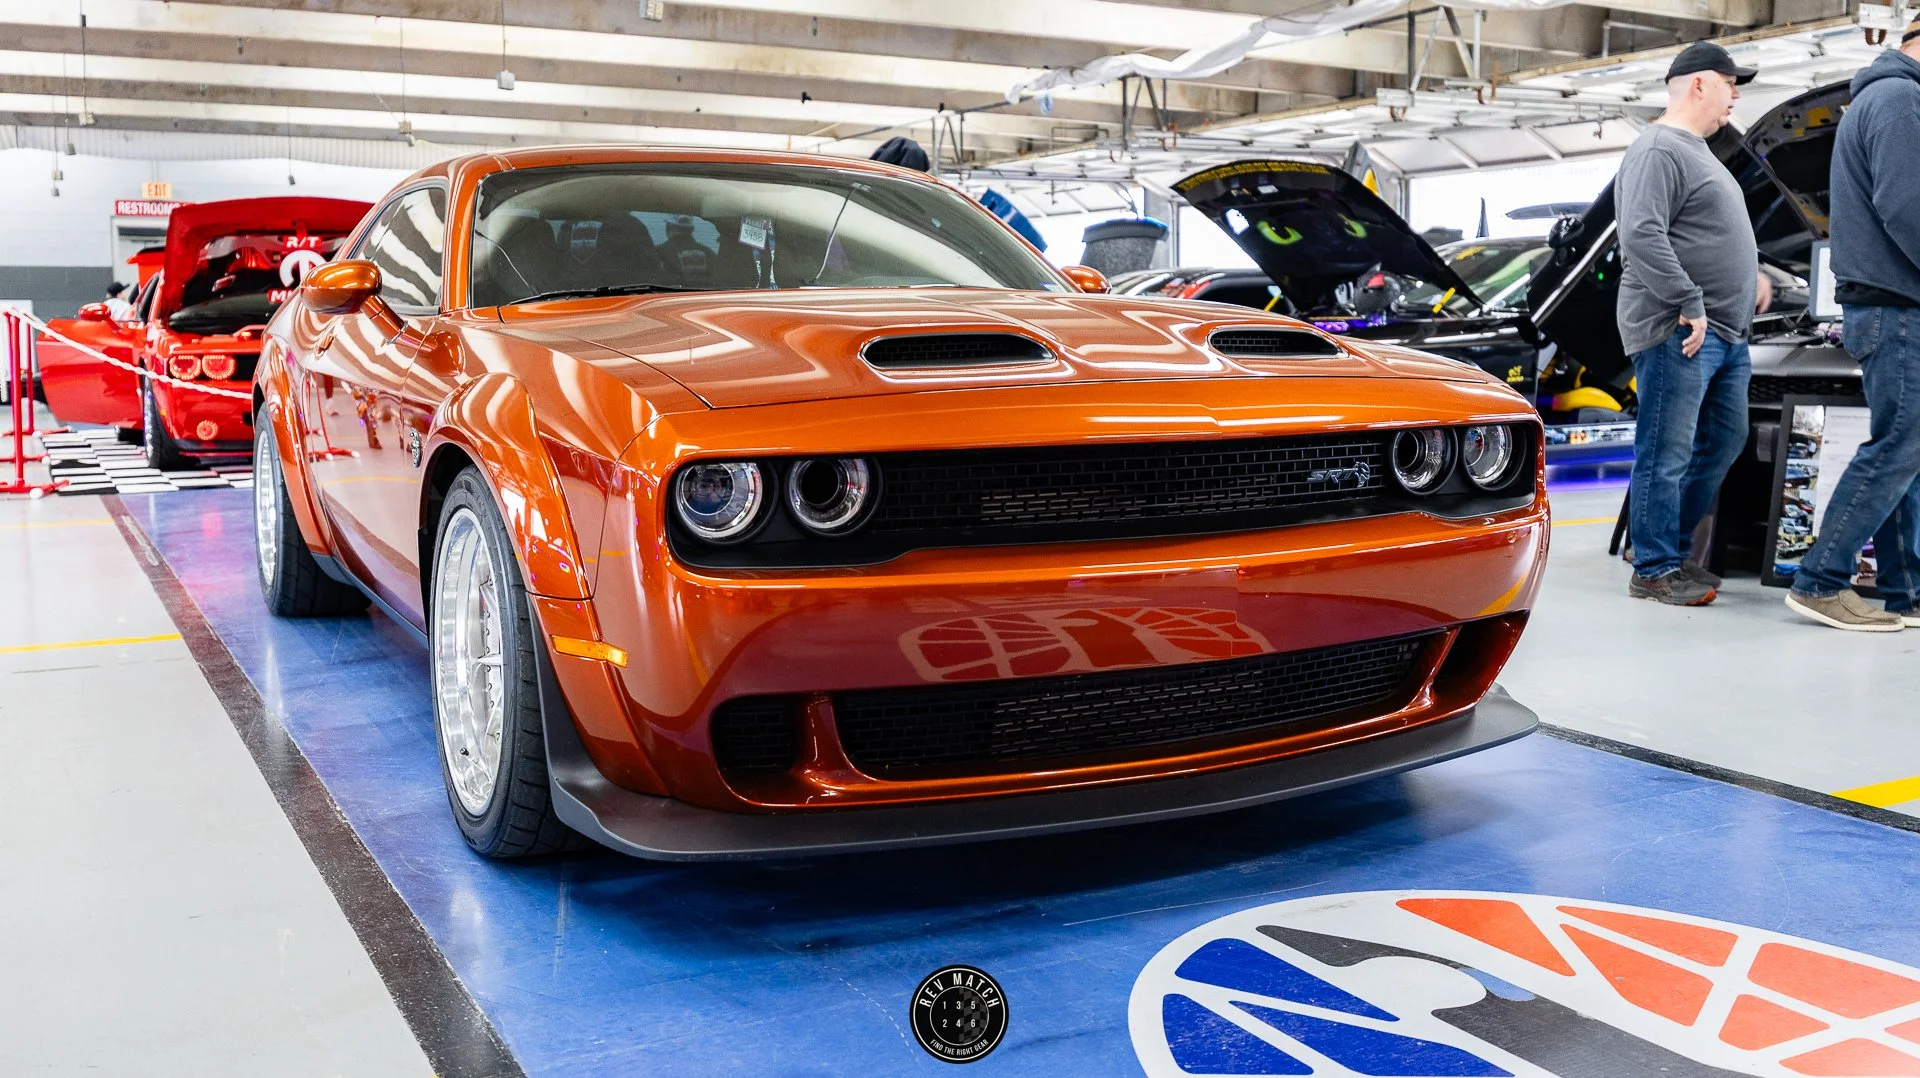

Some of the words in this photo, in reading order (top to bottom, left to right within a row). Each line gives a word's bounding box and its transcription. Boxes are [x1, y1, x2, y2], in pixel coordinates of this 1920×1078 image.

[147, 183, 168, 197] EXIT
[117, 201, 181, 215] RESTROOM
[286, 236, 319, 248] R/T
[1306, 467, 1359, 484] SRT
